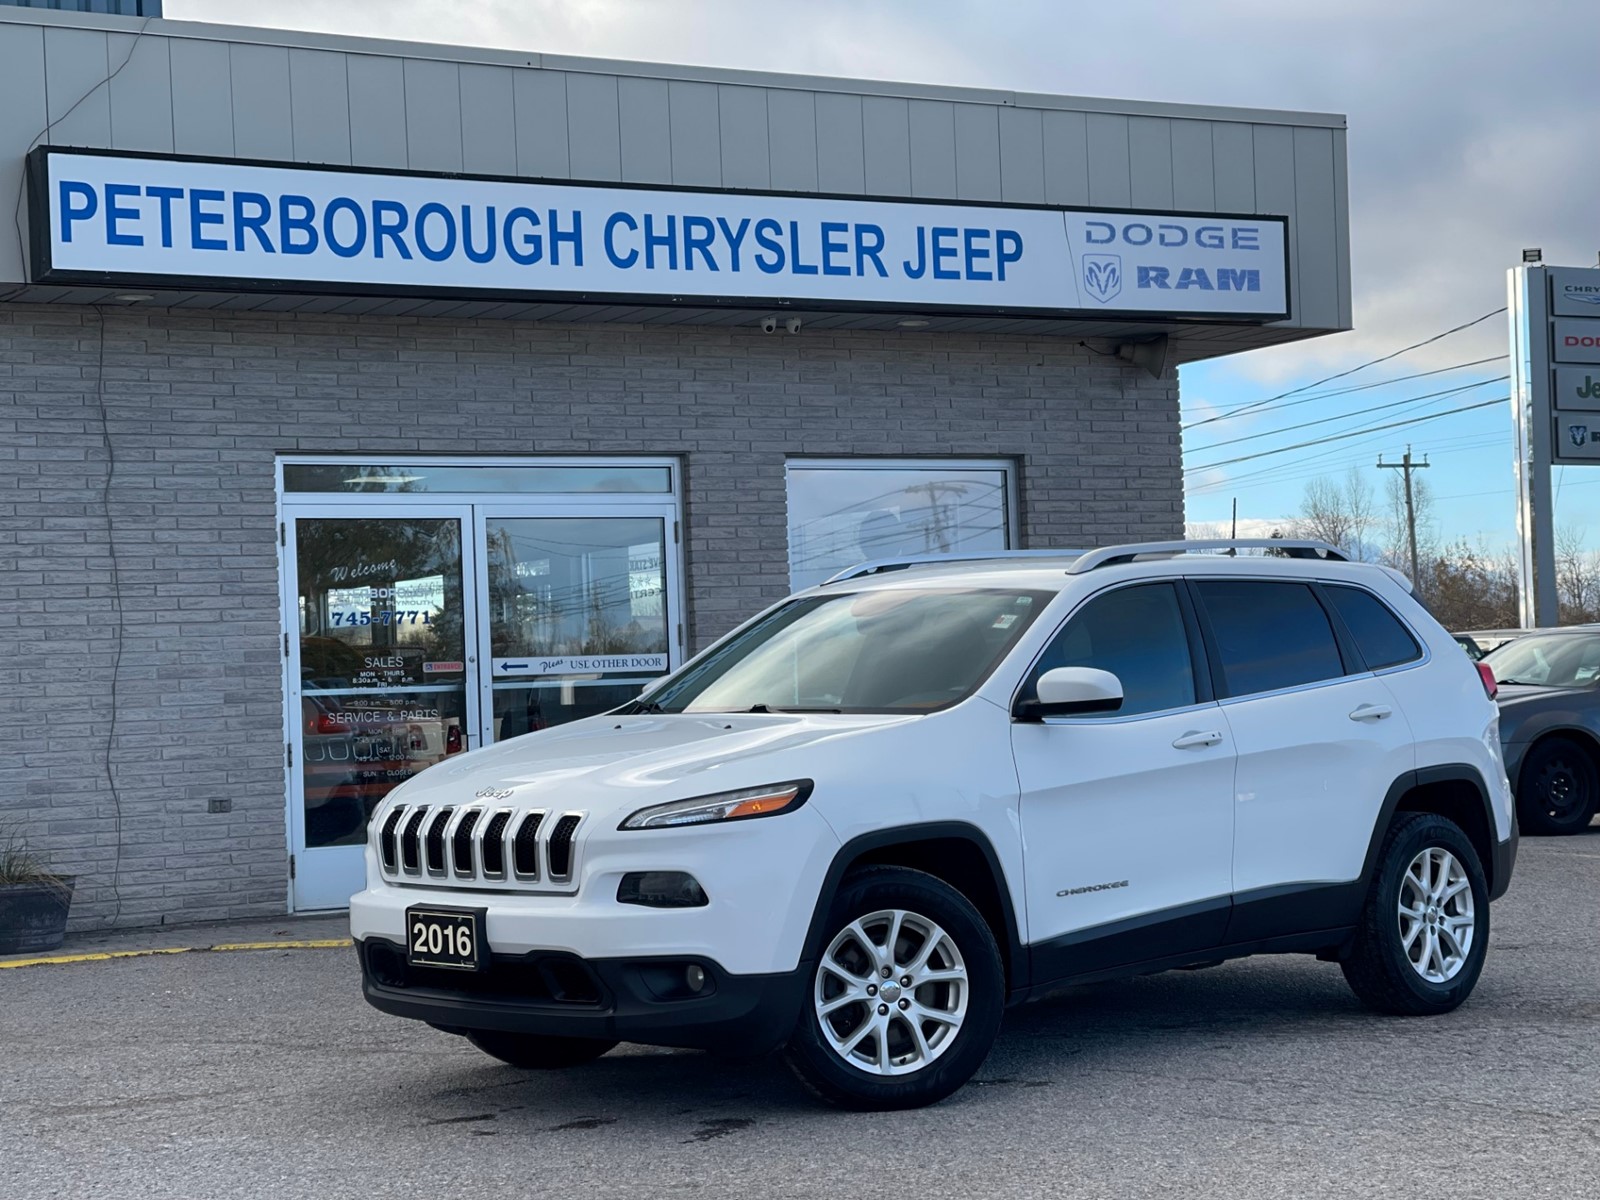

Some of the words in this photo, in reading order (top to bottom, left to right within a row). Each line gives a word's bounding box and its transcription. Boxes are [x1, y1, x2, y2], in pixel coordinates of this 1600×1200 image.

[59, 180, 584, 267] PETERBOROUGH
[604, 211, 889, 278] CHRYSLER
[903, 226, 1023, 282] JEEP
[1085, 221, 1260, 250] DODGE
[1136, 265, 1261, 292] RAM
[330, 559, 397, 582] Welcome
[331, 610, 432, 627] 745-7771
[364, 656, 404, 669] SALES
[570, 660, 590, 670] USE
[592, 659, 629, 669] OTHER
[631, 657, 662, 667] DOOR
[328, 711, 380, 724] SERVICE
[386, 711, 395, 722] &
[400, 709, 438, 722] PARTS
[363, 770, 377, 778] SUN
[476, 786, 514, 799] Jeep
[1056, 880, 1129, 897] CHEROKEE
[413, 922, 472, 957] 2016
